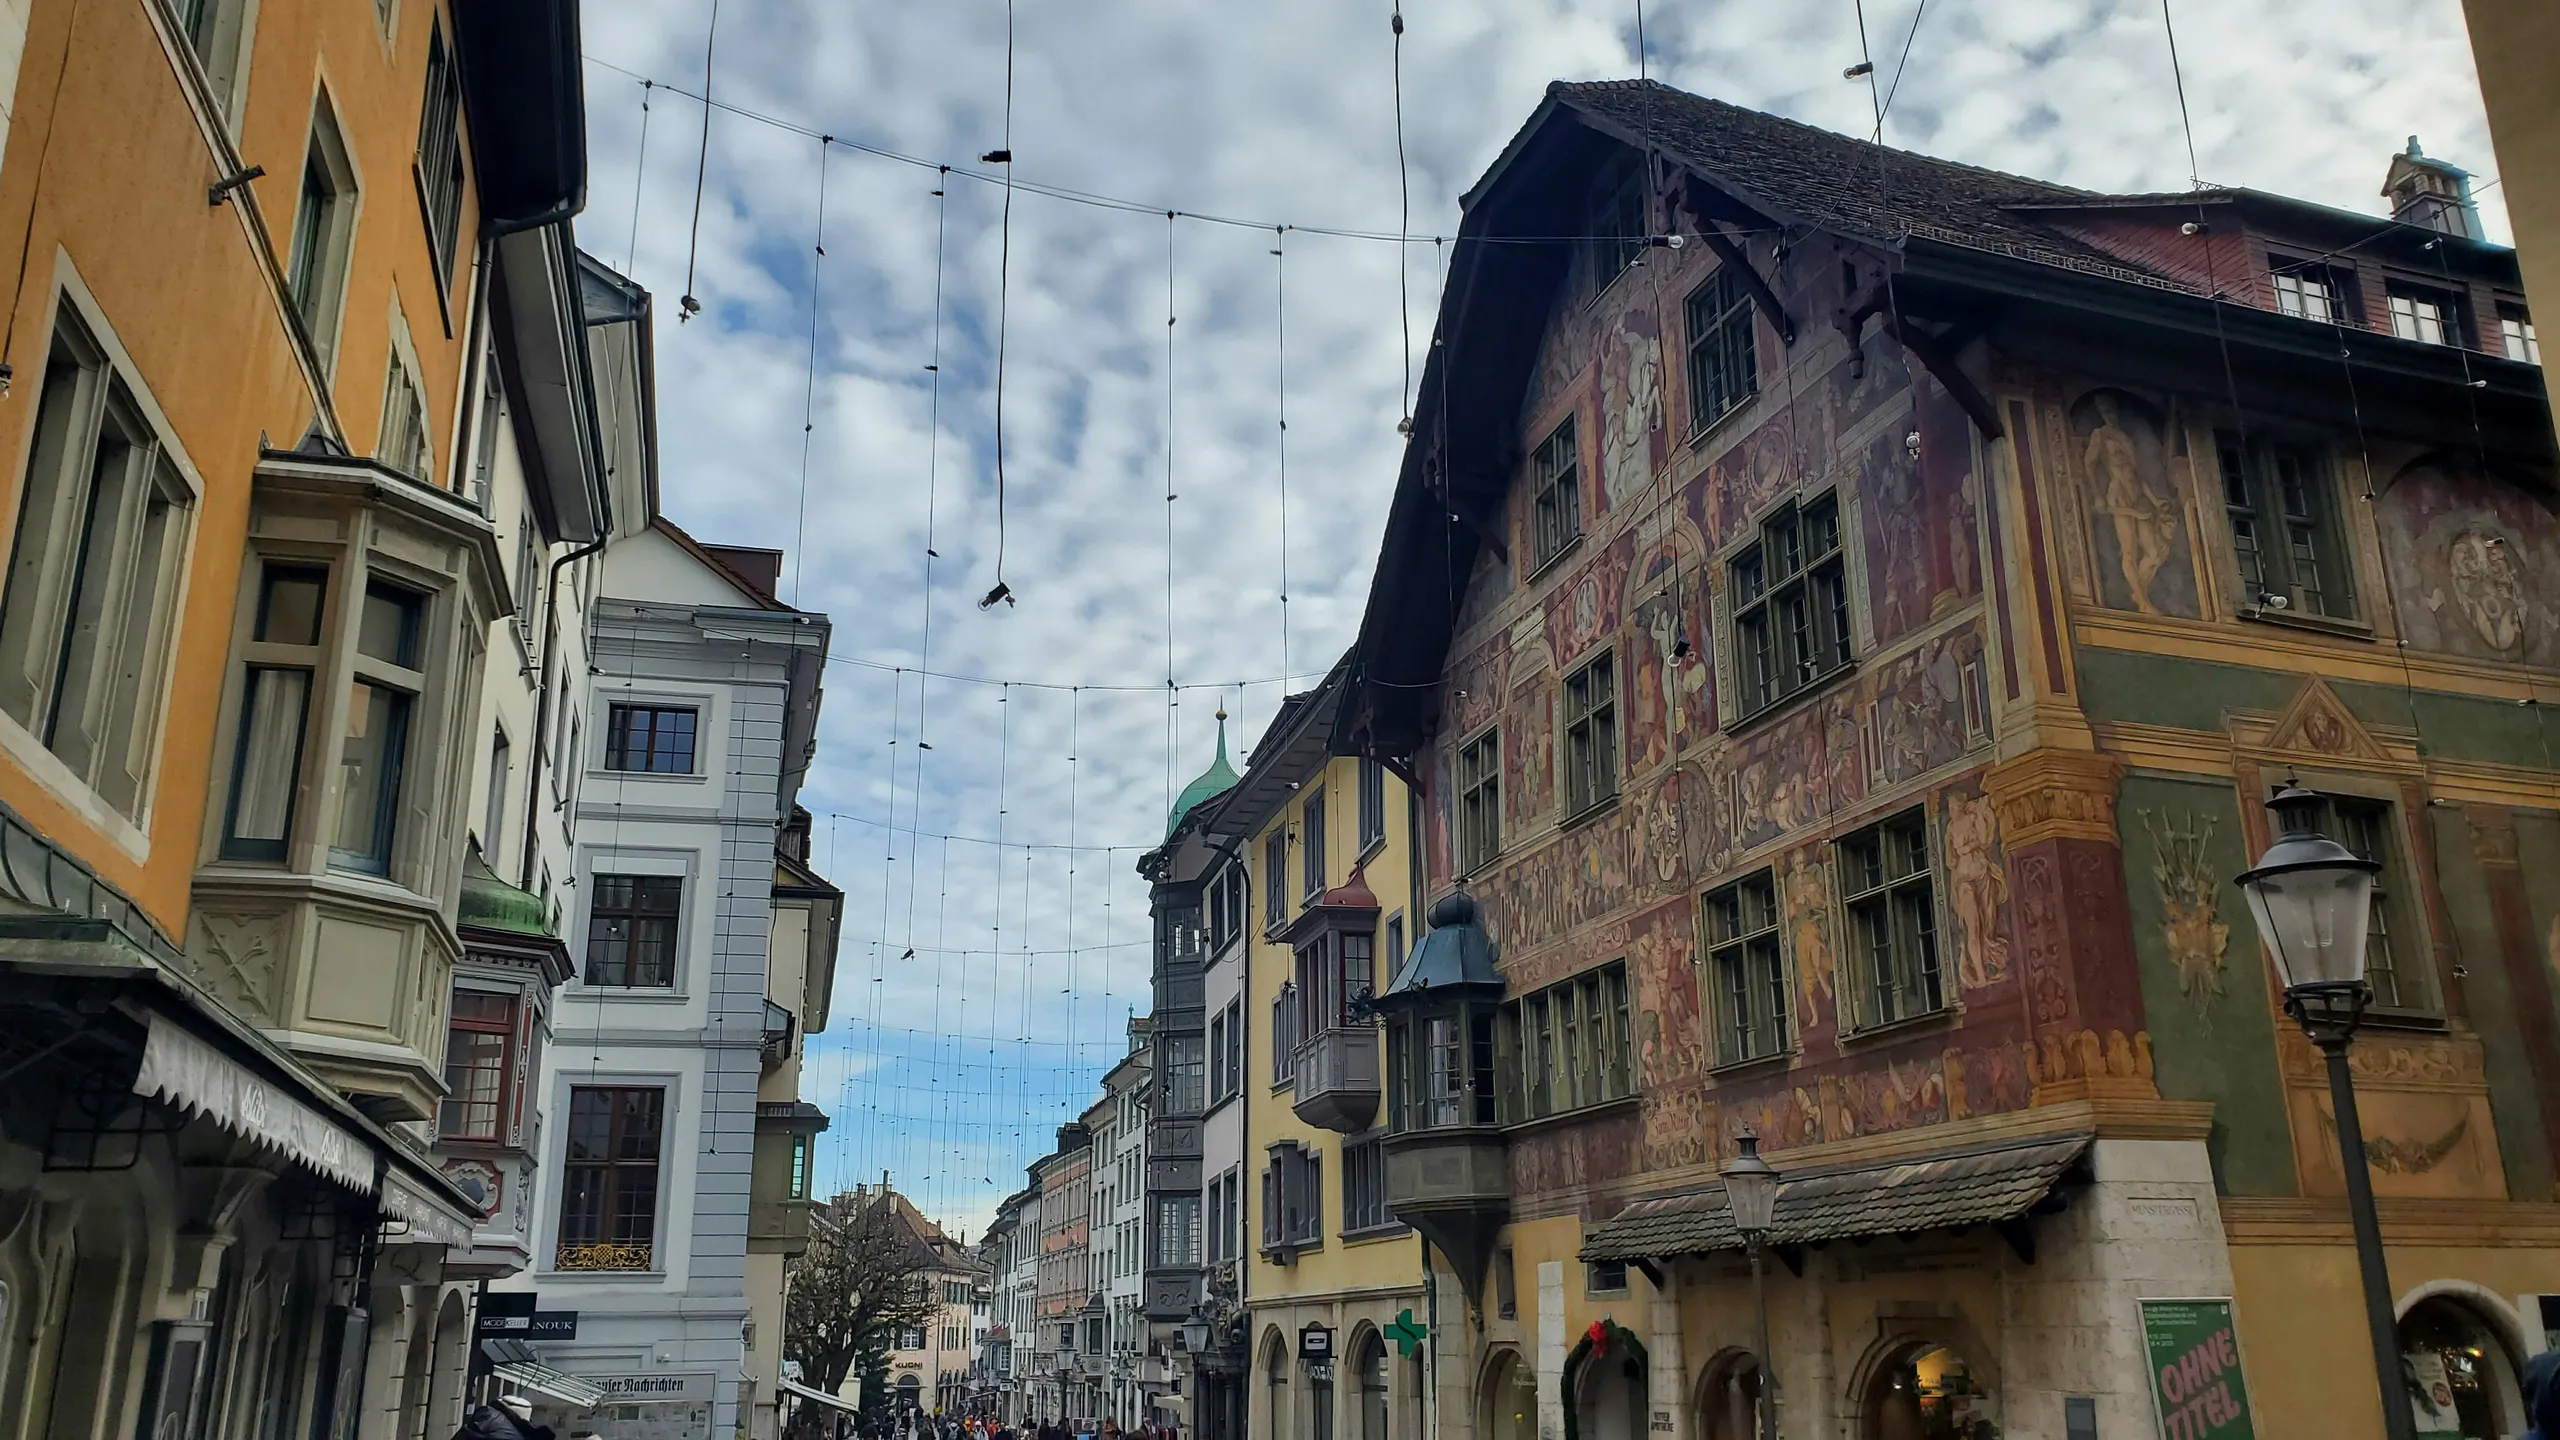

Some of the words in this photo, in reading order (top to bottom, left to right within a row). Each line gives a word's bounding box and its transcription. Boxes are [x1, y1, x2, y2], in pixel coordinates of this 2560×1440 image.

[532, 1321, 573, 1330] NOUK
[2161, 1327, 2238, 1404] OHNE
[624, 1378, 684, 1393] Nachrichten
[2165, 1381, 2241, 1440] TITEL
